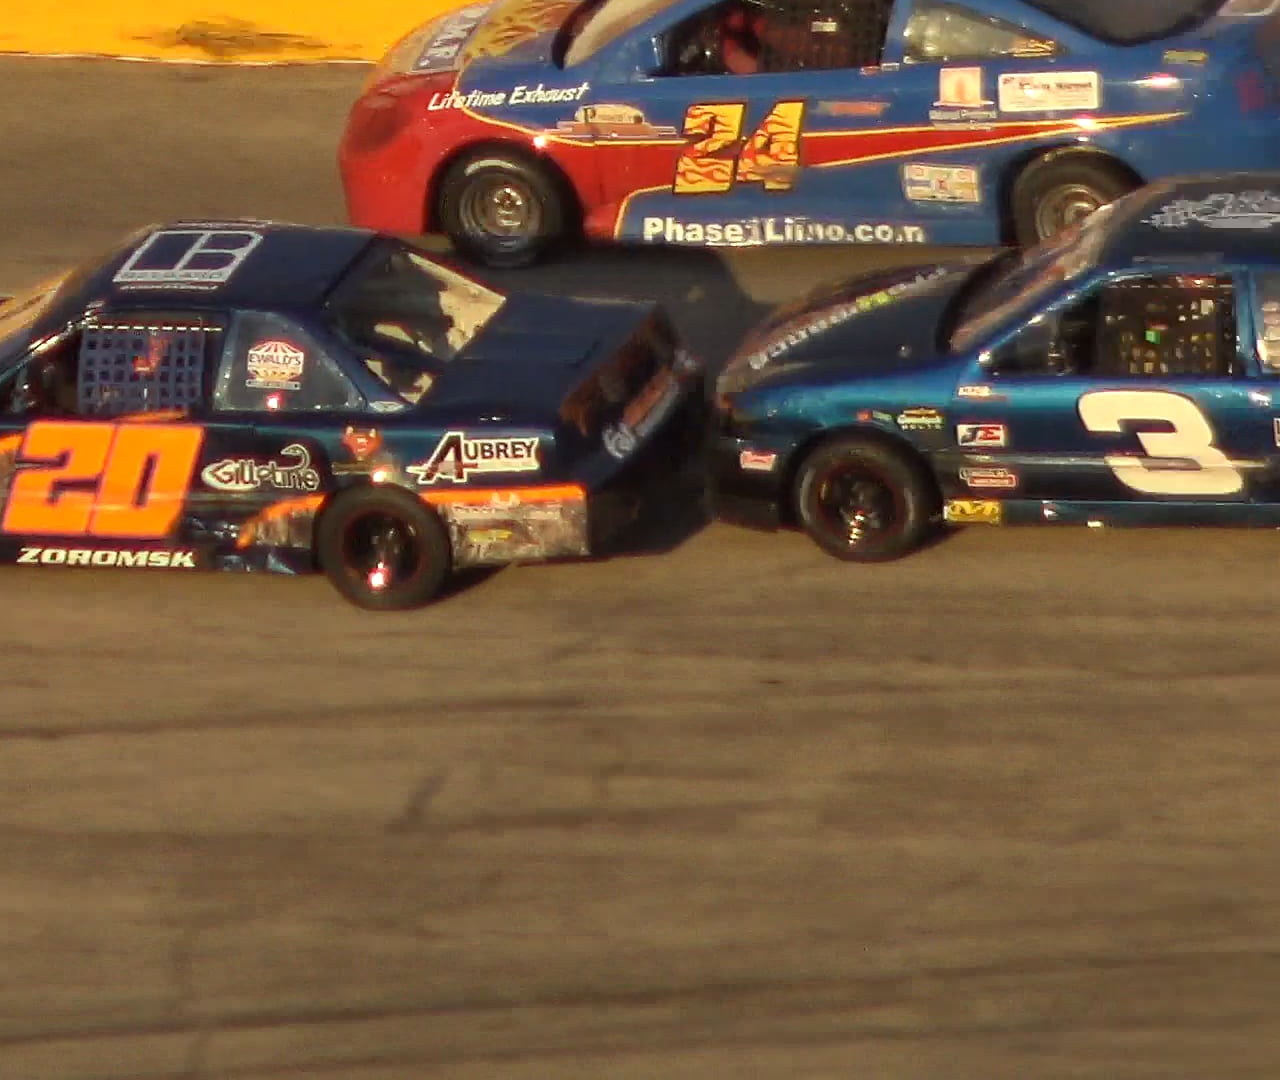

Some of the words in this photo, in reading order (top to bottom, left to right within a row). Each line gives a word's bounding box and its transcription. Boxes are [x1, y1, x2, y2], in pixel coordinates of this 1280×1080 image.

[673, 99, 806, 195] 24
[0, 420, 204, 536] 20
[1078, 390, 1243, 495] 3
[17, 547, 194, 568] ZOROMSK
